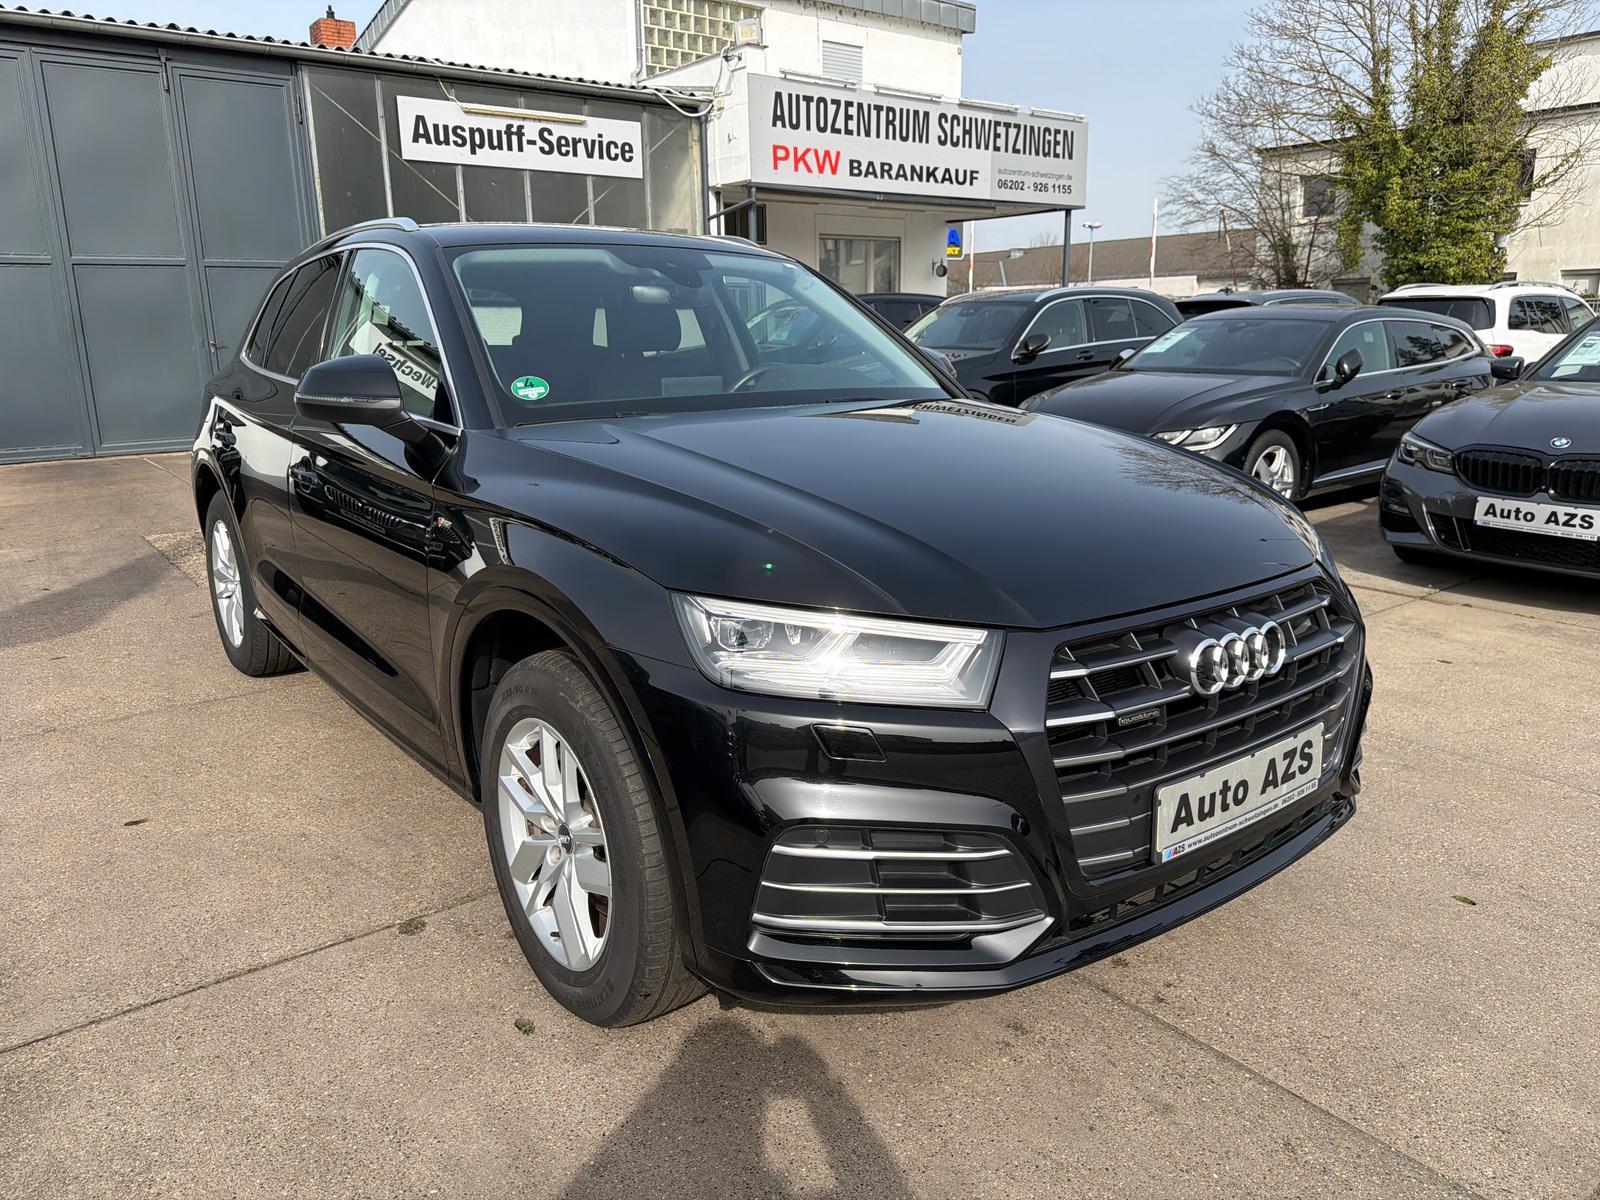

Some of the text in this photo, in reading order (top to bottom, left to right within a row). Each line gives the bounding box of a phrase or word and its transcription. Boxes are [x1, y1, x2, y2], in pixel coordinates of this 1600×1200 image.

[411, 114, 635, 163] Auspuff-Service
[771, 91, 1075, 160] AUTOZENTRUM SCHWETZINGEN
[772, 144, 980, 186] PKW BARANKAUF
[997, 179, 1025, 191] 06202
[1032, 182, 1049, 193] 926
[1051, 183, 1073, 195] 1155
[524, 377, 535, 388] 4
[1483, 503, 1536, 523] Auto
[1543, 511, 1595, 530] AZS
[1121, 710, 1160, 725] quattro
[1170, 739, 1314, 834] Auto AZS
[1173, 844, 1186, 856] AZS
